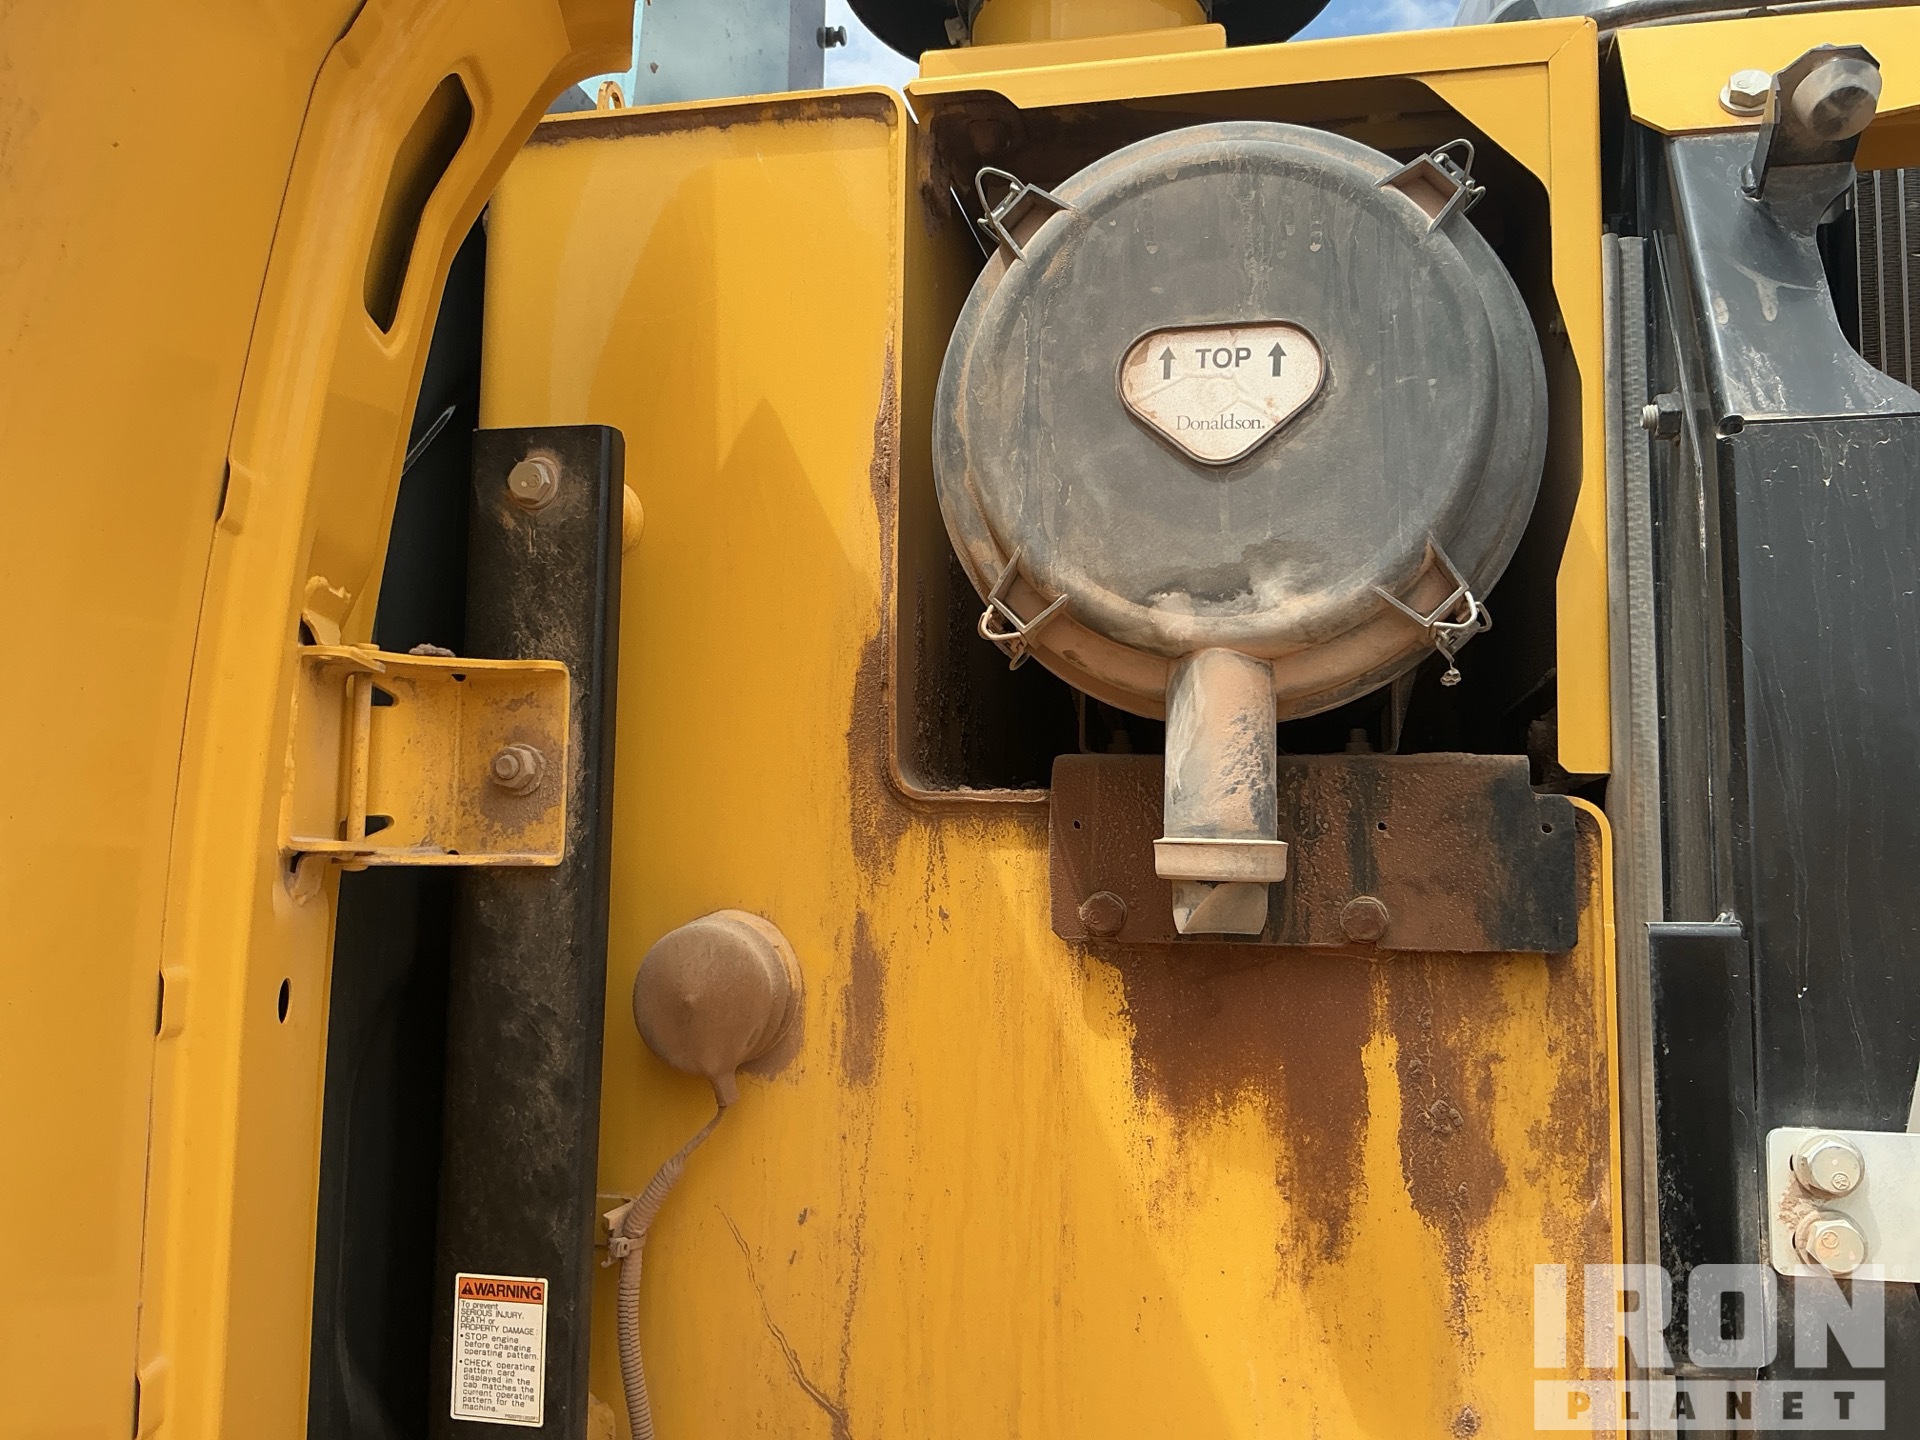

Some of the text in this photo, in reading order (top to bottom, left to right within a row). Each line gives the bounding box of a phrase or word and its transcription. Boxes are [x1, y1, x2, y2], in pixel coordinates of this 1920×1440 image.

[1195, 347, 1252, 369] TOP
[474, 1282, 542, 1300] WARNING
[461, 1300, 499, 1310] To prevent
[461, 1308, 492, 1317] SERIOUS
[460, 1316, 486, 1324] DEATH
[460, 1323, 499, 1332] PROPERTY
[465, 1332, 519, 1344] STOP engine
[465, 1340, 531, 1353] before changing
[464, 1348, 539, 1360] operating pattern.
[464, 1358, 535, 1372] CHECK operating
[463, 1366, 493, 1375] pattern
[463, 1373, 501, 1383] displayed
[482, 1383, 517, 1392] matches
[462, 1389, 535, 1402] current operating
[462, 1396, 492, 1404] pattern
[496, 1398, 507, 1406] for
[462, 1403, 498, 1412] machine.
